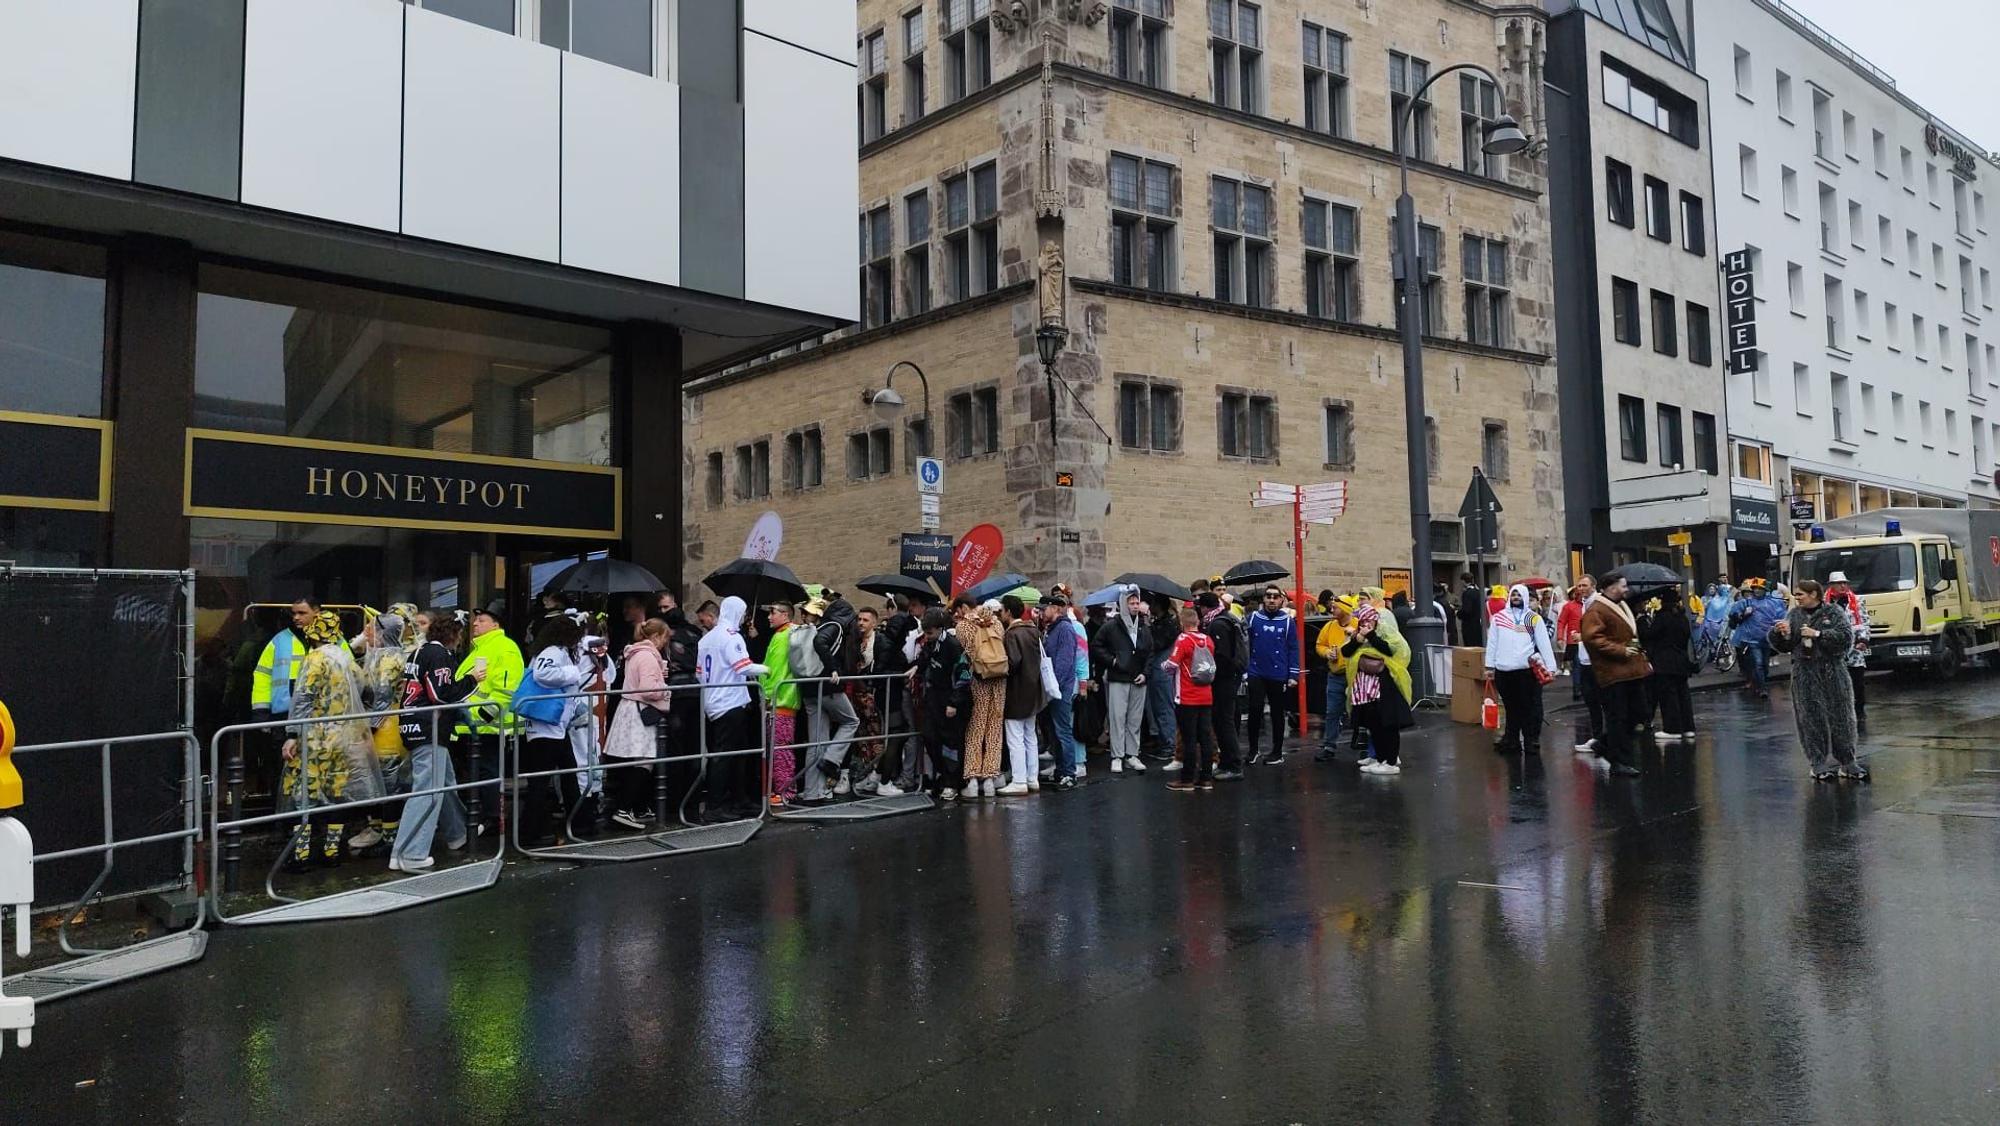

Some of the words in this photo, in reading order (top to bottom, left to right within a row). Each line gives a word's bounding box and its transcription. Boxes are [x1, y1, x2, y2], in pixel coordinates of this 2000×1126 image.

[1731, 253, 1751, 369] HOTEL
[306, 467, 530, 509] HONEYPOT
[914, 553, 939, 563] Zugang
[955, 565, 972, 586] Mehr
[537, 657, 554, 670] 72
[704, 654, 712, 683] 9
[434, 667, 452, 687] 72
